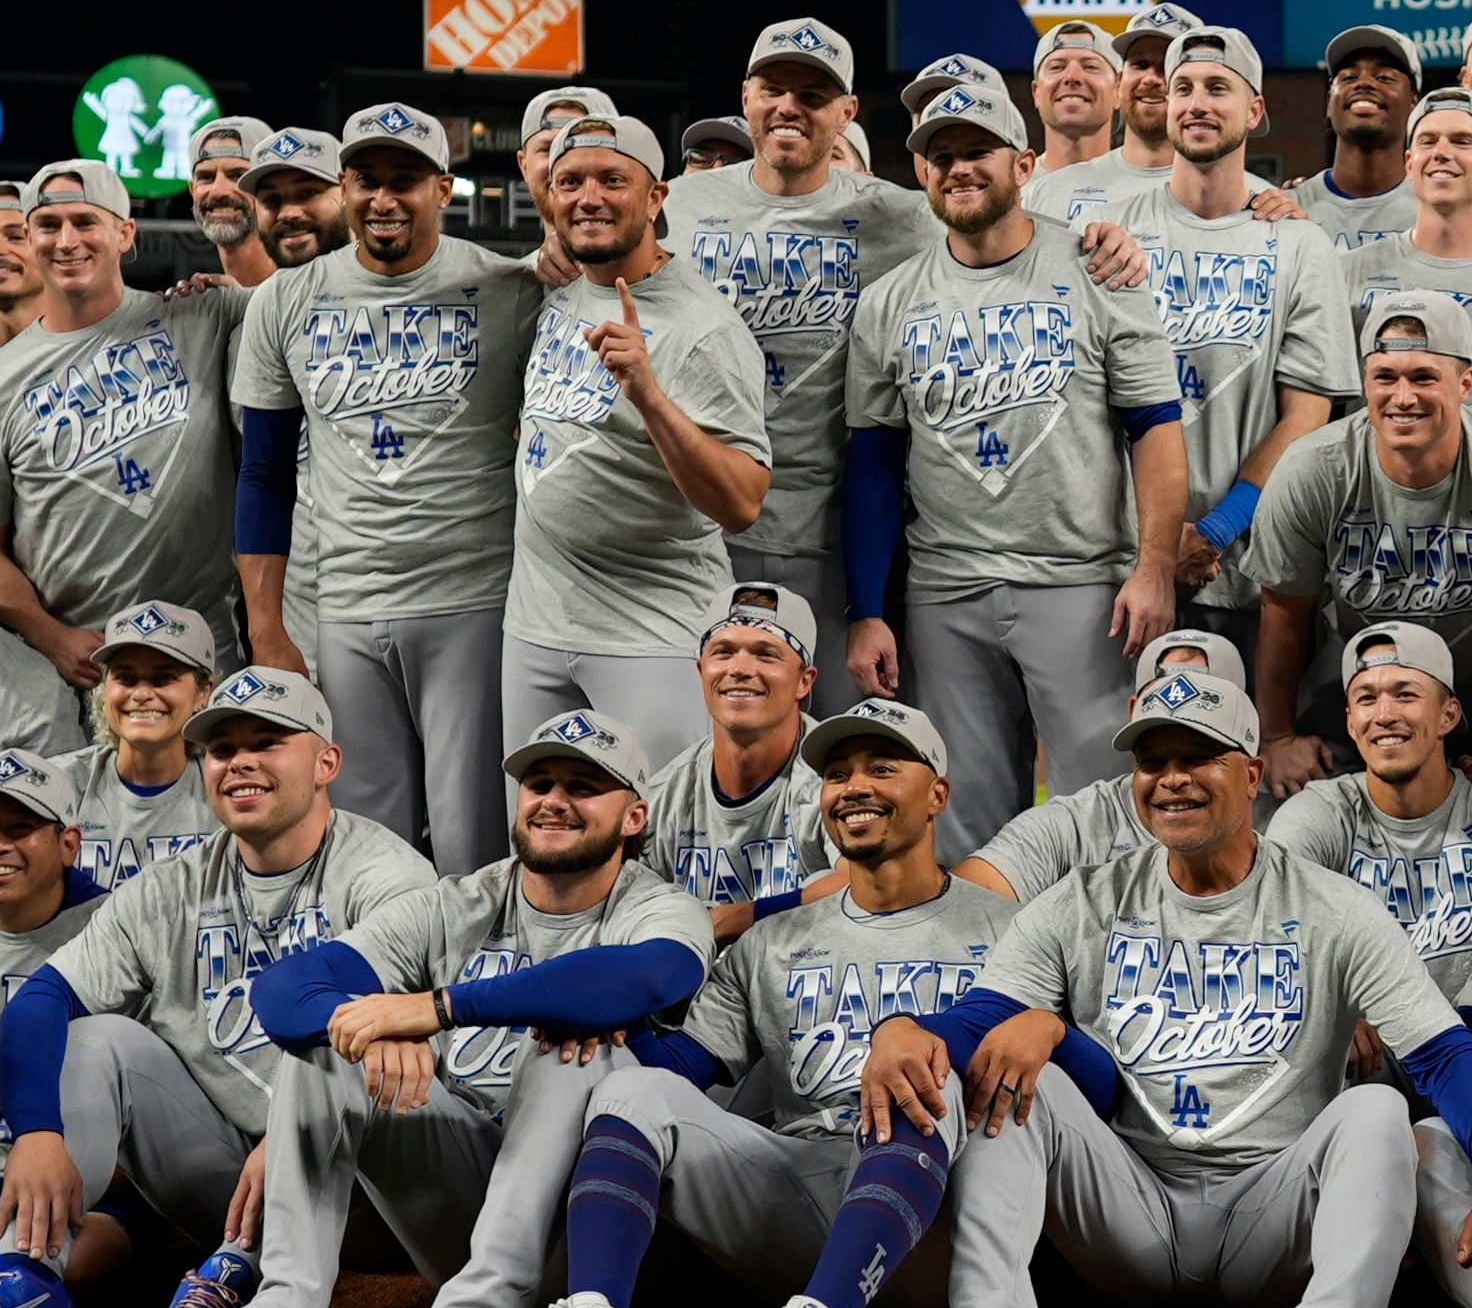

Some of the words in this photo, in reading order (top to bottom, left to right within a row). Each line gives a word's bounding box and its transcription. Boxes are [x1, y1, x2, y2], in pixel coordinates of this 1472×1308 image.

[797, 29, 819, 51] LA
[385, 107, 404, 130] LA
[948, 91, 967, 113] LA
[692, 231, 862, 299] TAKE
[304, 305, 480, 371] TAKE
[904, 301, 1076, 384] TAKE
[25, 329, 190, 431] TAKE
[309, 346, 477, 417] October
[917, 345, 1076, 427] October
[39, 380, 191, 475] October
[370, 415, 404, 460] LA
[976, 421, 1009, 467] LA
[117, 452, 152, 495] LA
[138, 609, 160, 631] LA
[232, 676, 255, 699] LA
[1167, 681, 1188, 705] LA
[564, 718, 586, 742] LA
[1107, 934, 1303, 1021] TAKE
[1110, 994, 1303, 1066] October
[1170, 1075, 1210, 1130] LA
[857, 1242, 887, 1305] LA
